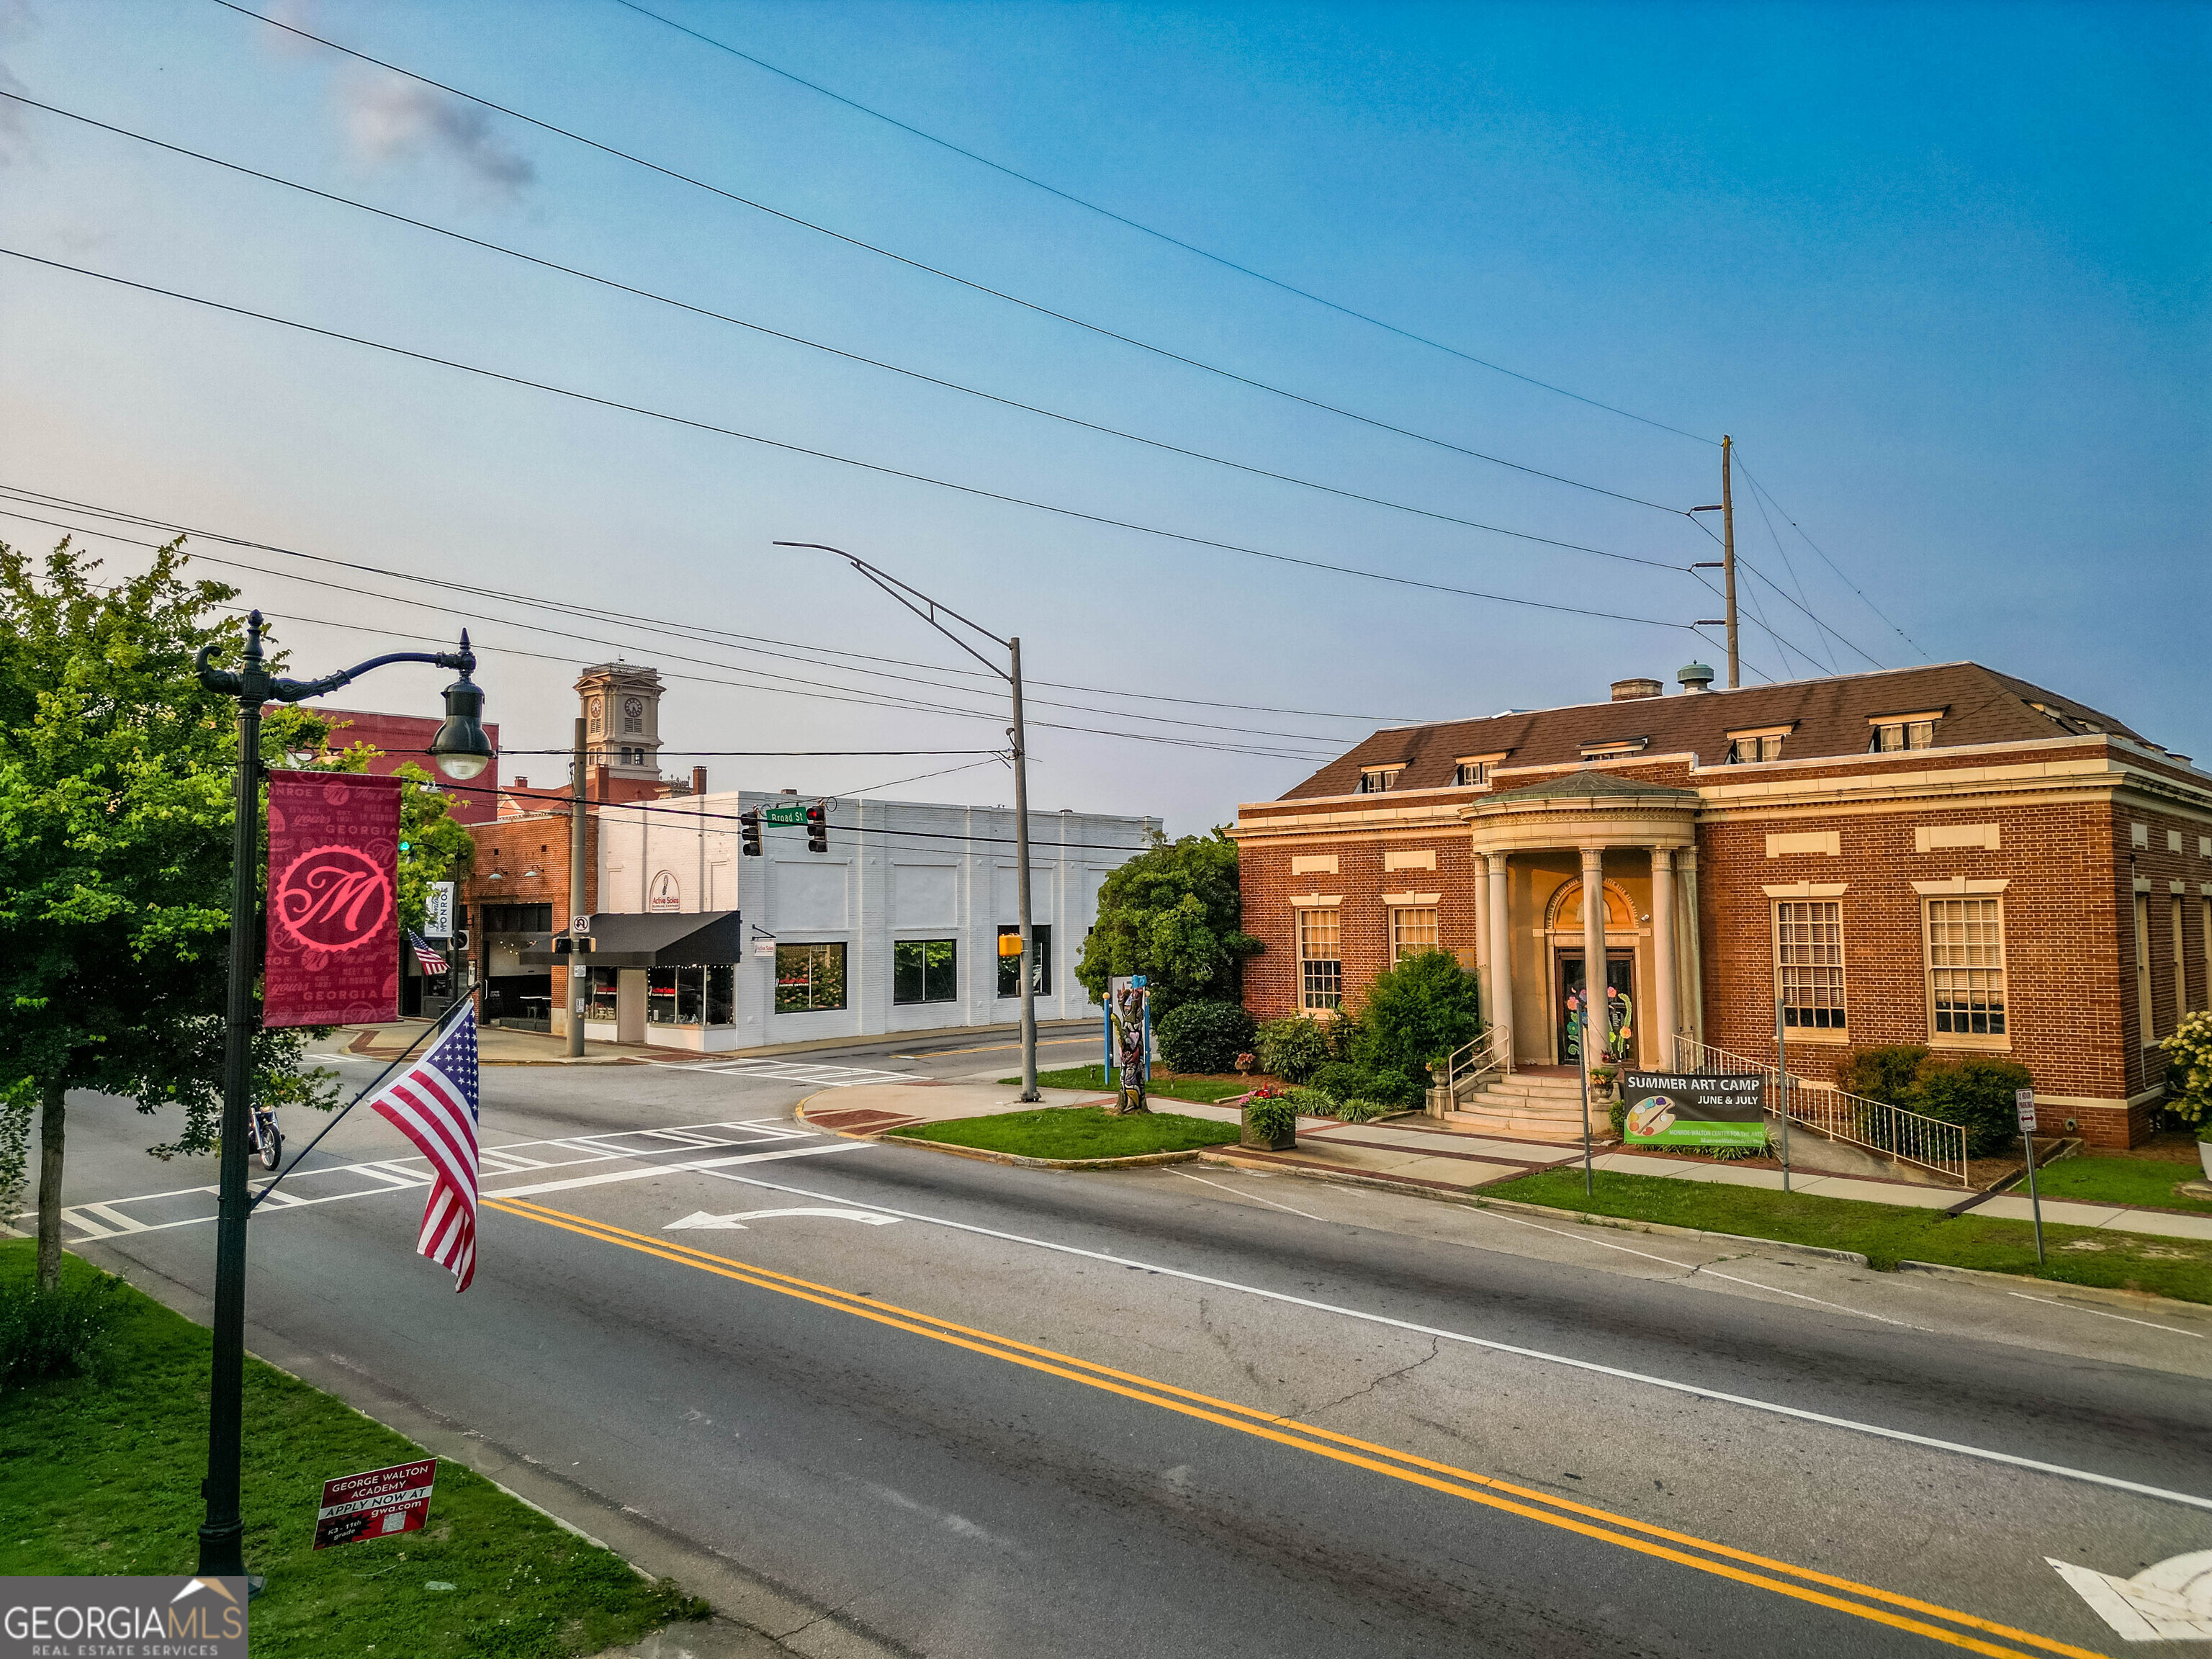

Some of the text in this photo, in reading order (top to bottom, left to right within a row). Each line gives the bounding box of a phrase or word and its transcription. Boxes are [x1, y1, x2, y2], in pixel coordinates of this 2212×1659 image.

[771, 811, 803, 822] Broad St
[325, 824, 398, 835] GEORGIA
[282, 866, 383, 932] M
[303, 990, 378, 1001] GEORGIA
[1627, 1076, 1687, 1089] SUMMER
[1691, 1079, 1717, 1090] ART
[1719, 1079, 1760, 1091] CAMP
[1697, 1095, 1758, 1105] JUNE & JULY
[332, 1465, 428, 1492] GEORGE WALTON
[351, 1480, 406, 1498] ACADEMY
[325, 1488, 426, 1517] APPLY NOW AT
[371, 1501, 422, 1518] gwa.com
[333, 1529, 356, 1540] grade
